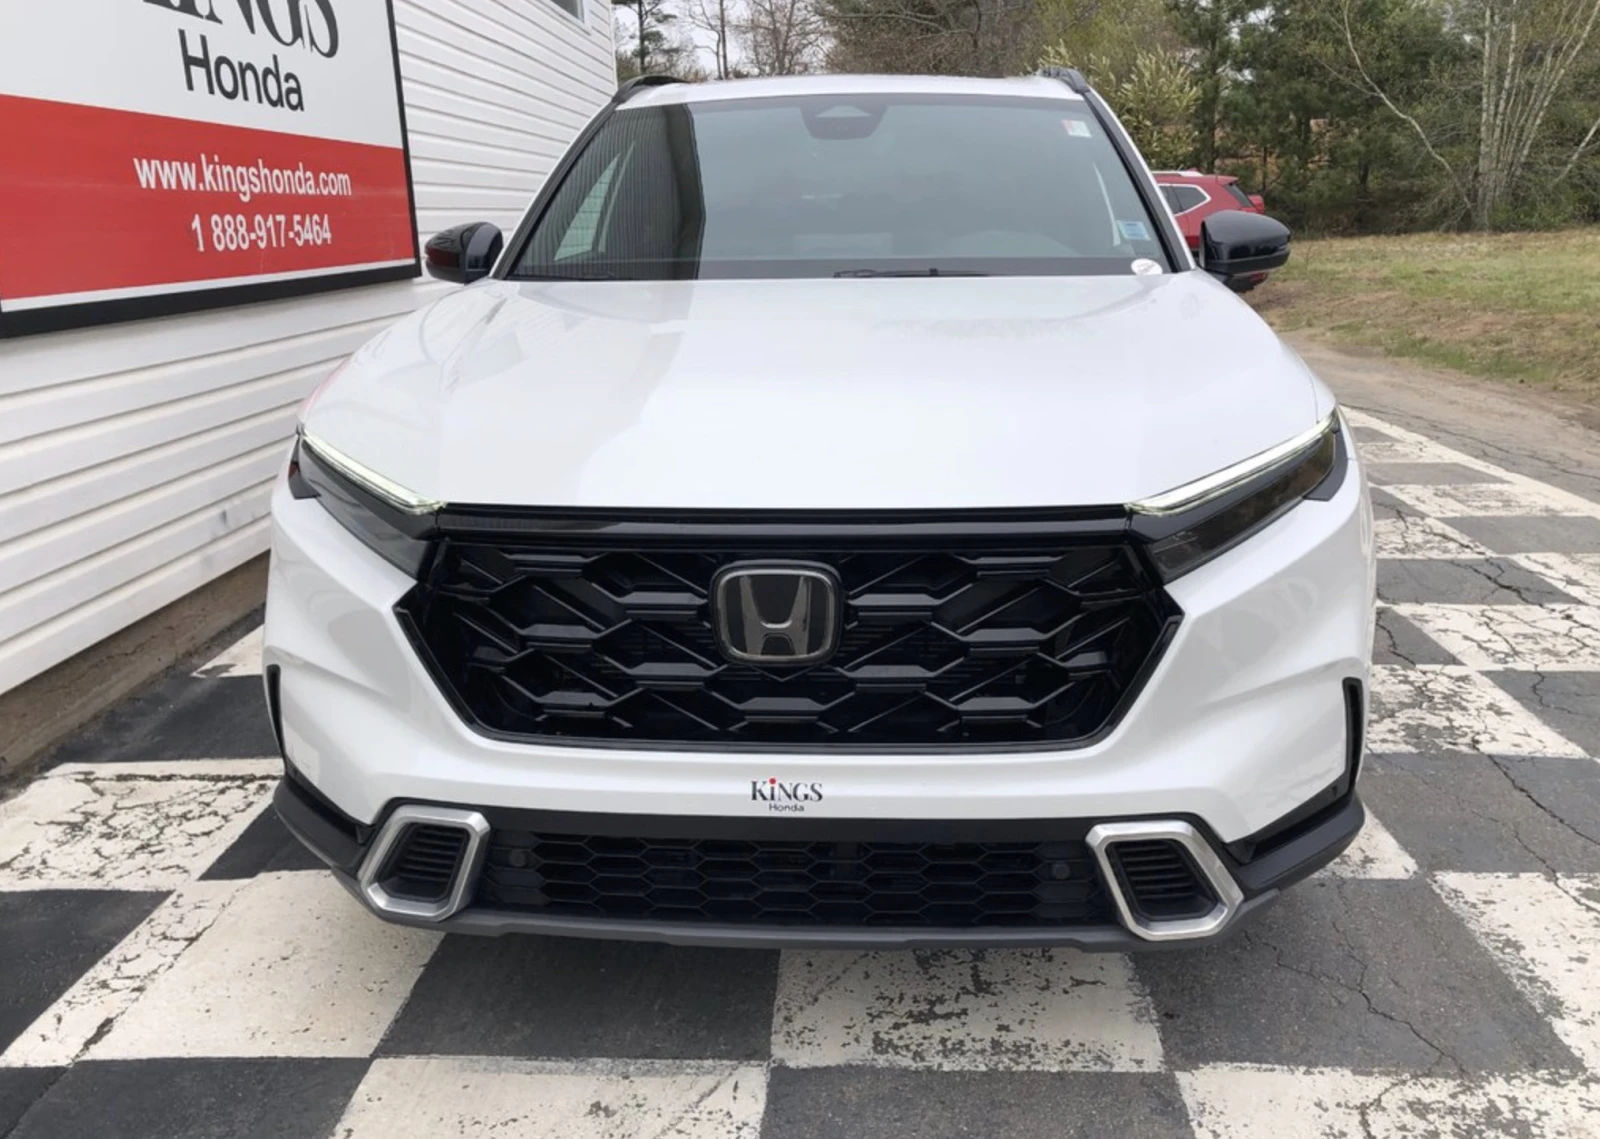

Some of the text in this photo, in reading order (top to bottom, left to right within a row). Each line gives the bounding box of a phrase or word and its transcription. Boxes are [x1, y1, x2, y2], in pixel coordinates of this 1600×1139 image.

[178, 28, 304, 111] Honda
[133, 153, 352, 203] www.kingshonda.com
[191, 213, 332, 252] 1 888-917-5464
[768, 803, 805, 812] Honda
